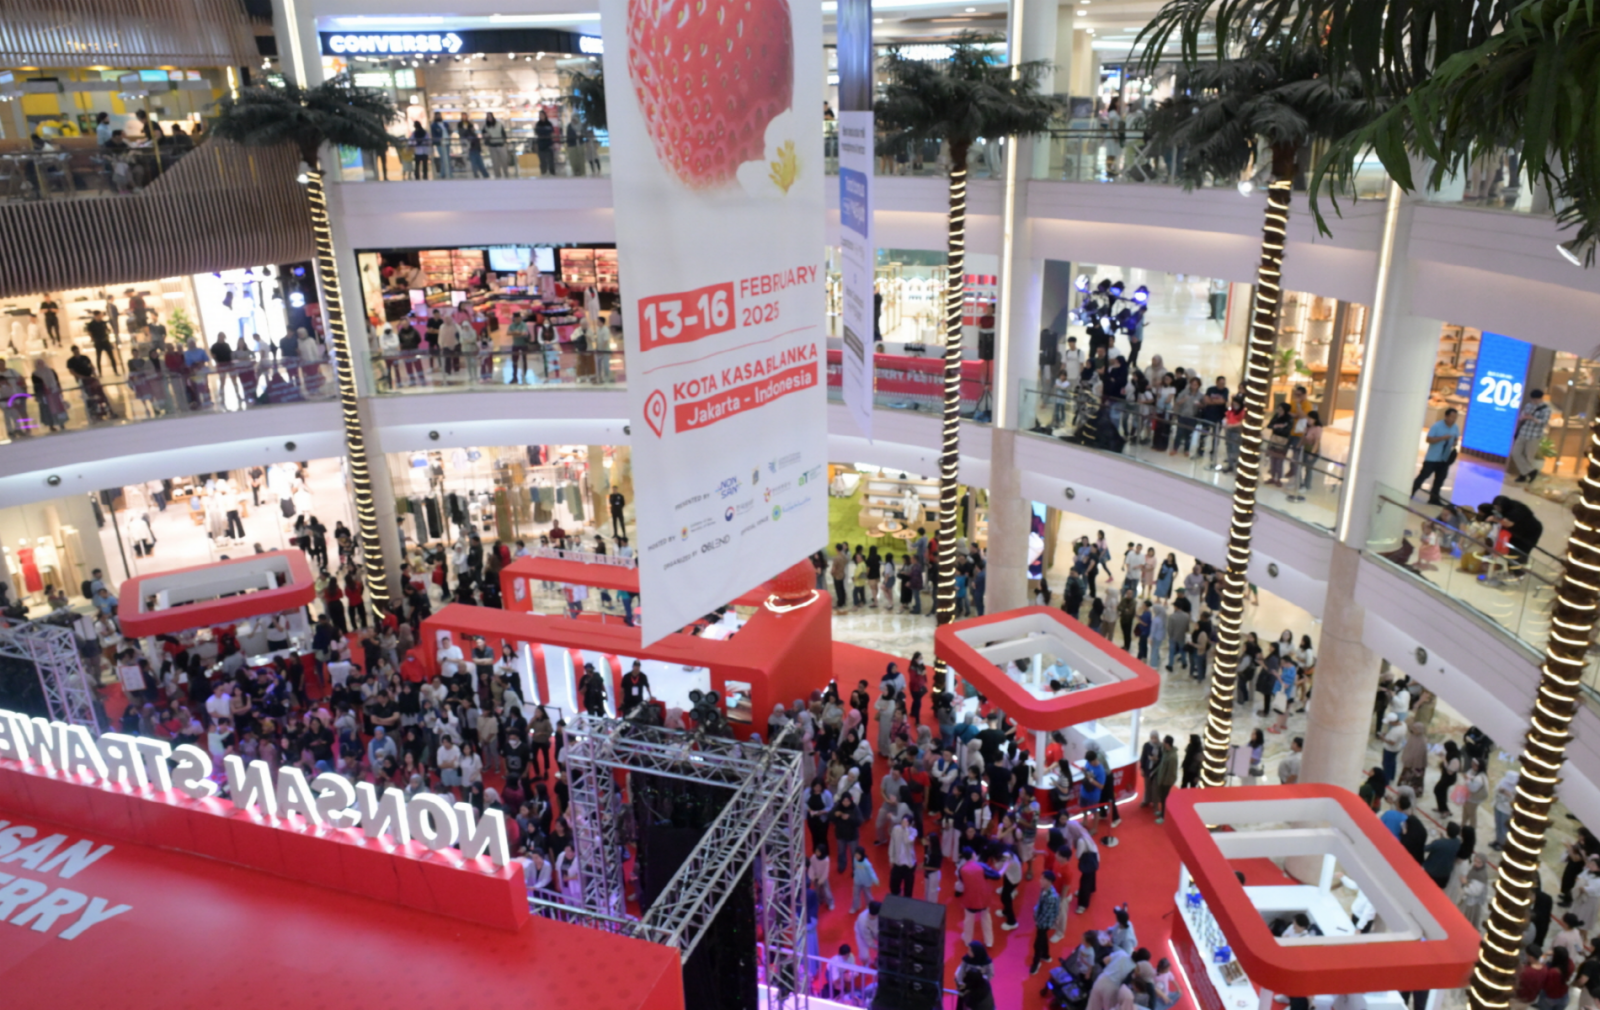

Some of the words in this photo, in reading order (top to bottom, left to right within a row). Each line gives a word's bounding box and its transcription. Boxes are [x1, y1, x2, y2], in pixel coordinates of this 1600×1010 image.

[329, 34, 443, 54] CONVERSE
[739, 264, 818, 299] FEBRUARY
[643, 290, 730, 342] 13-16
[742, 301, 780, 327] 2025
[672, 374, 718, 401] KOTA
[721, 342, 818, 387] KASABLANKA
[686, 395, 740, 426] Jakarta
[754, 370, 813, 403] Indonesia
